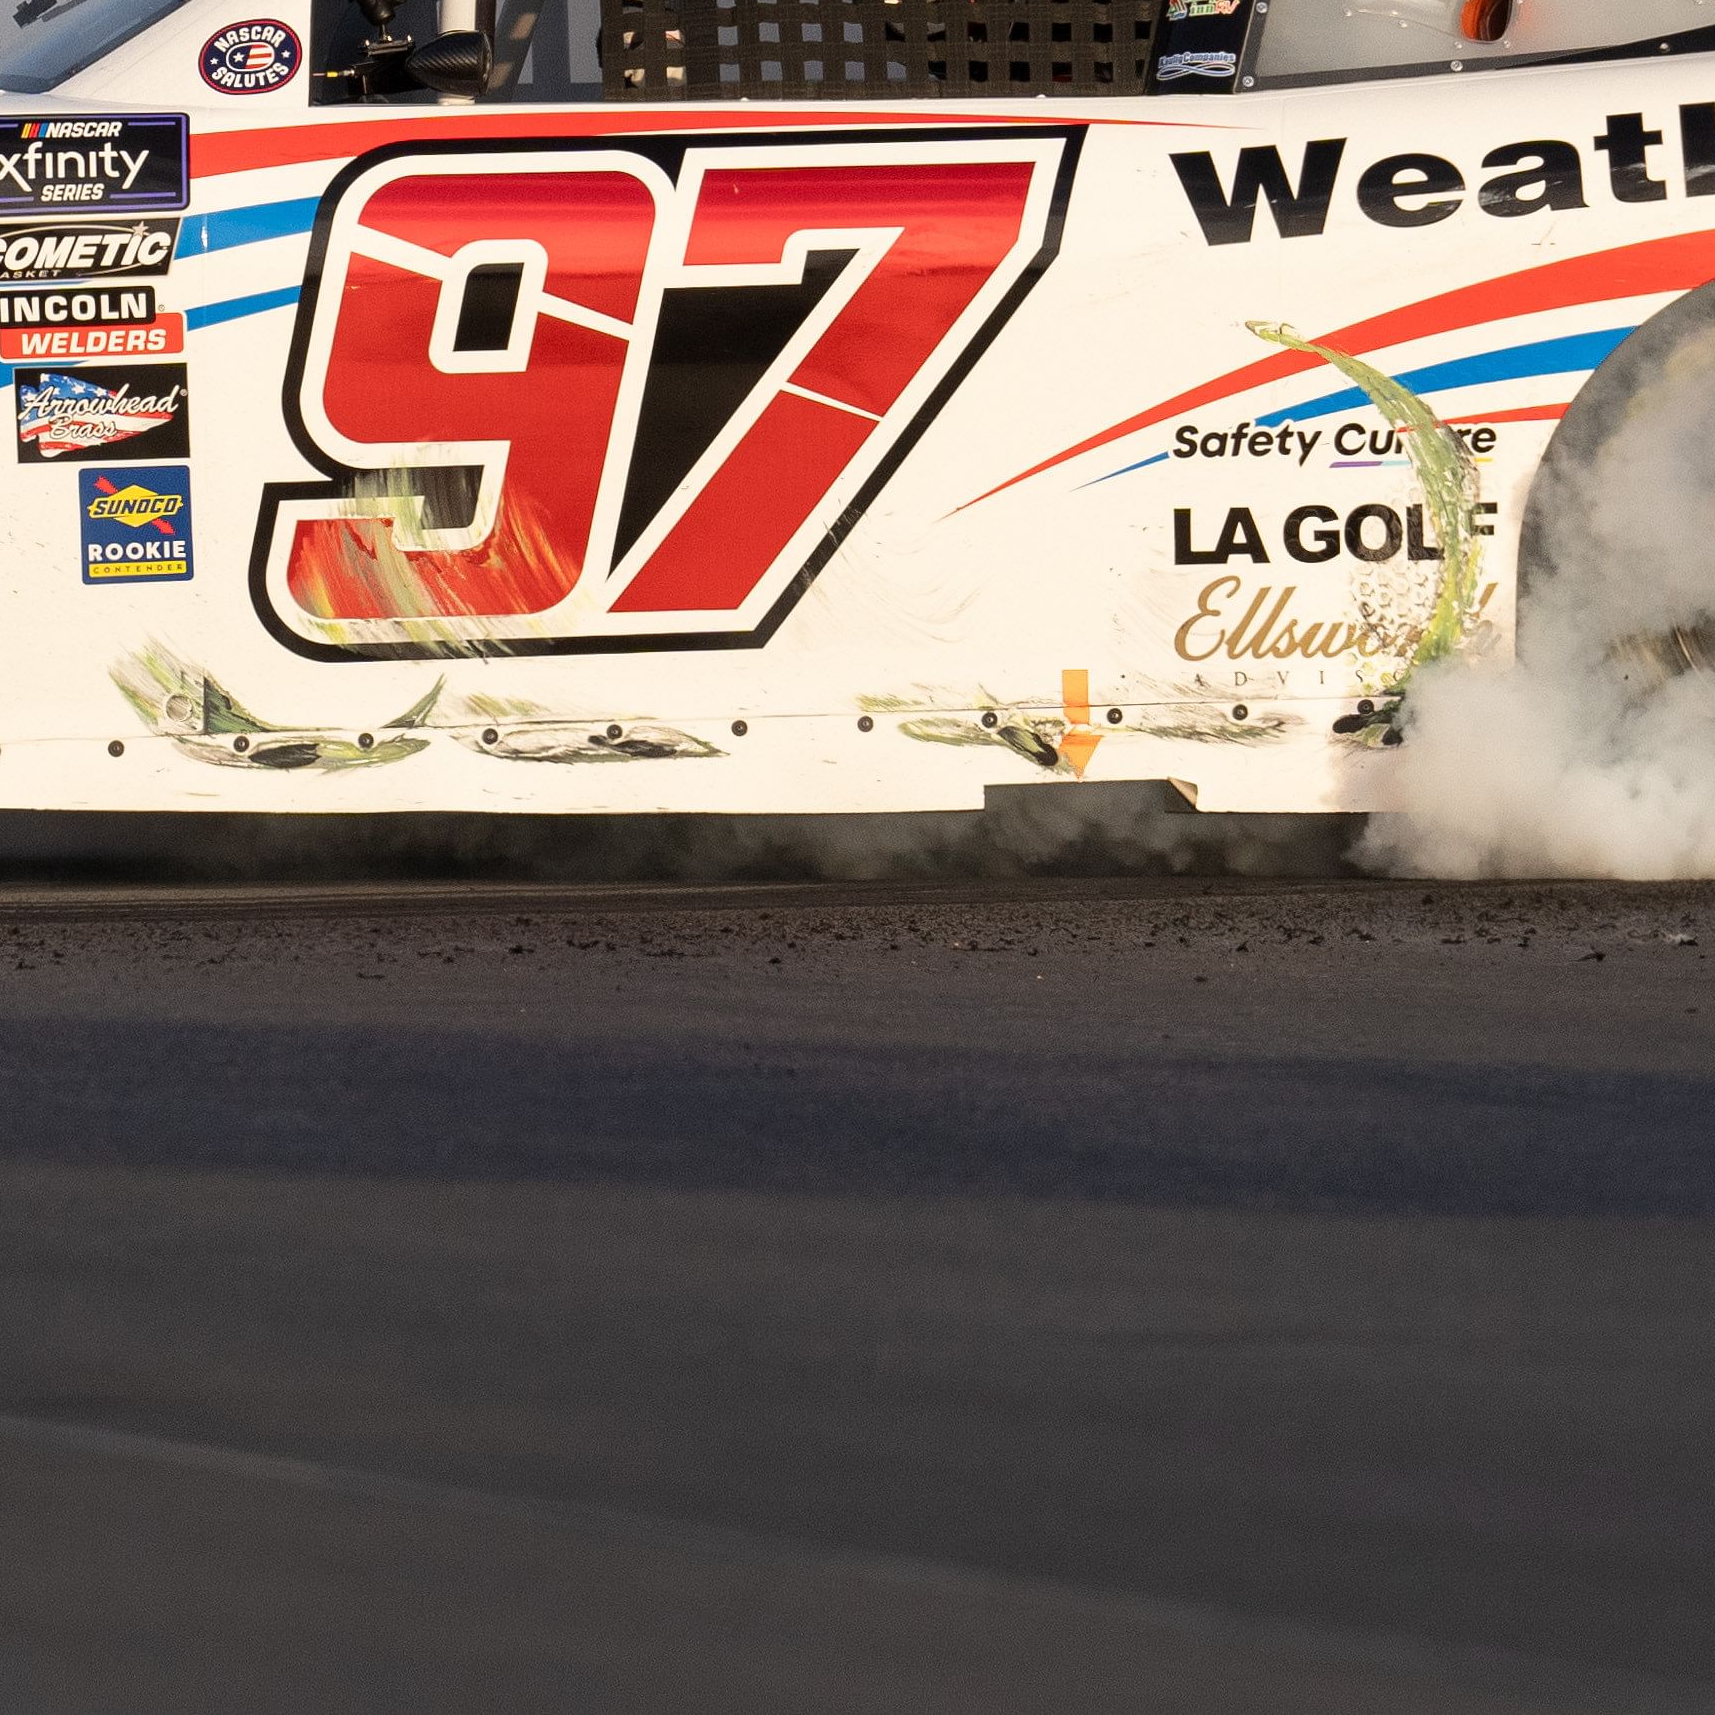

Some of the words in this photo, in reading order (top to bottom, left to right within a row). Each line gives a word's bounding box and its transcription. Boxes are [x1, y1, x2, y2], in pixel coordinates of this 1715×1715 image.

[214, 26, 286, 52] NASCAR
[212, 62, 289, 88] SALUTES
[45, 122, 123, 138] NASCAR
[41, 183, 105, 202] SERIES
[21, 329, 166, 355] WELDERS
[18, 383, 180, 420] Arrowhead
[260, 135, 1077, 651] 97
[48, 415, 119, 439] Brass
[1173, 421, 1322, 467] Safety
[93, 497, 179, 516] SUNOCO
[1173, 507, 1270, 566] LA
[88, 540, 187, 562] ROOKIE
[93, 564, 183, 575] CONTENDER
